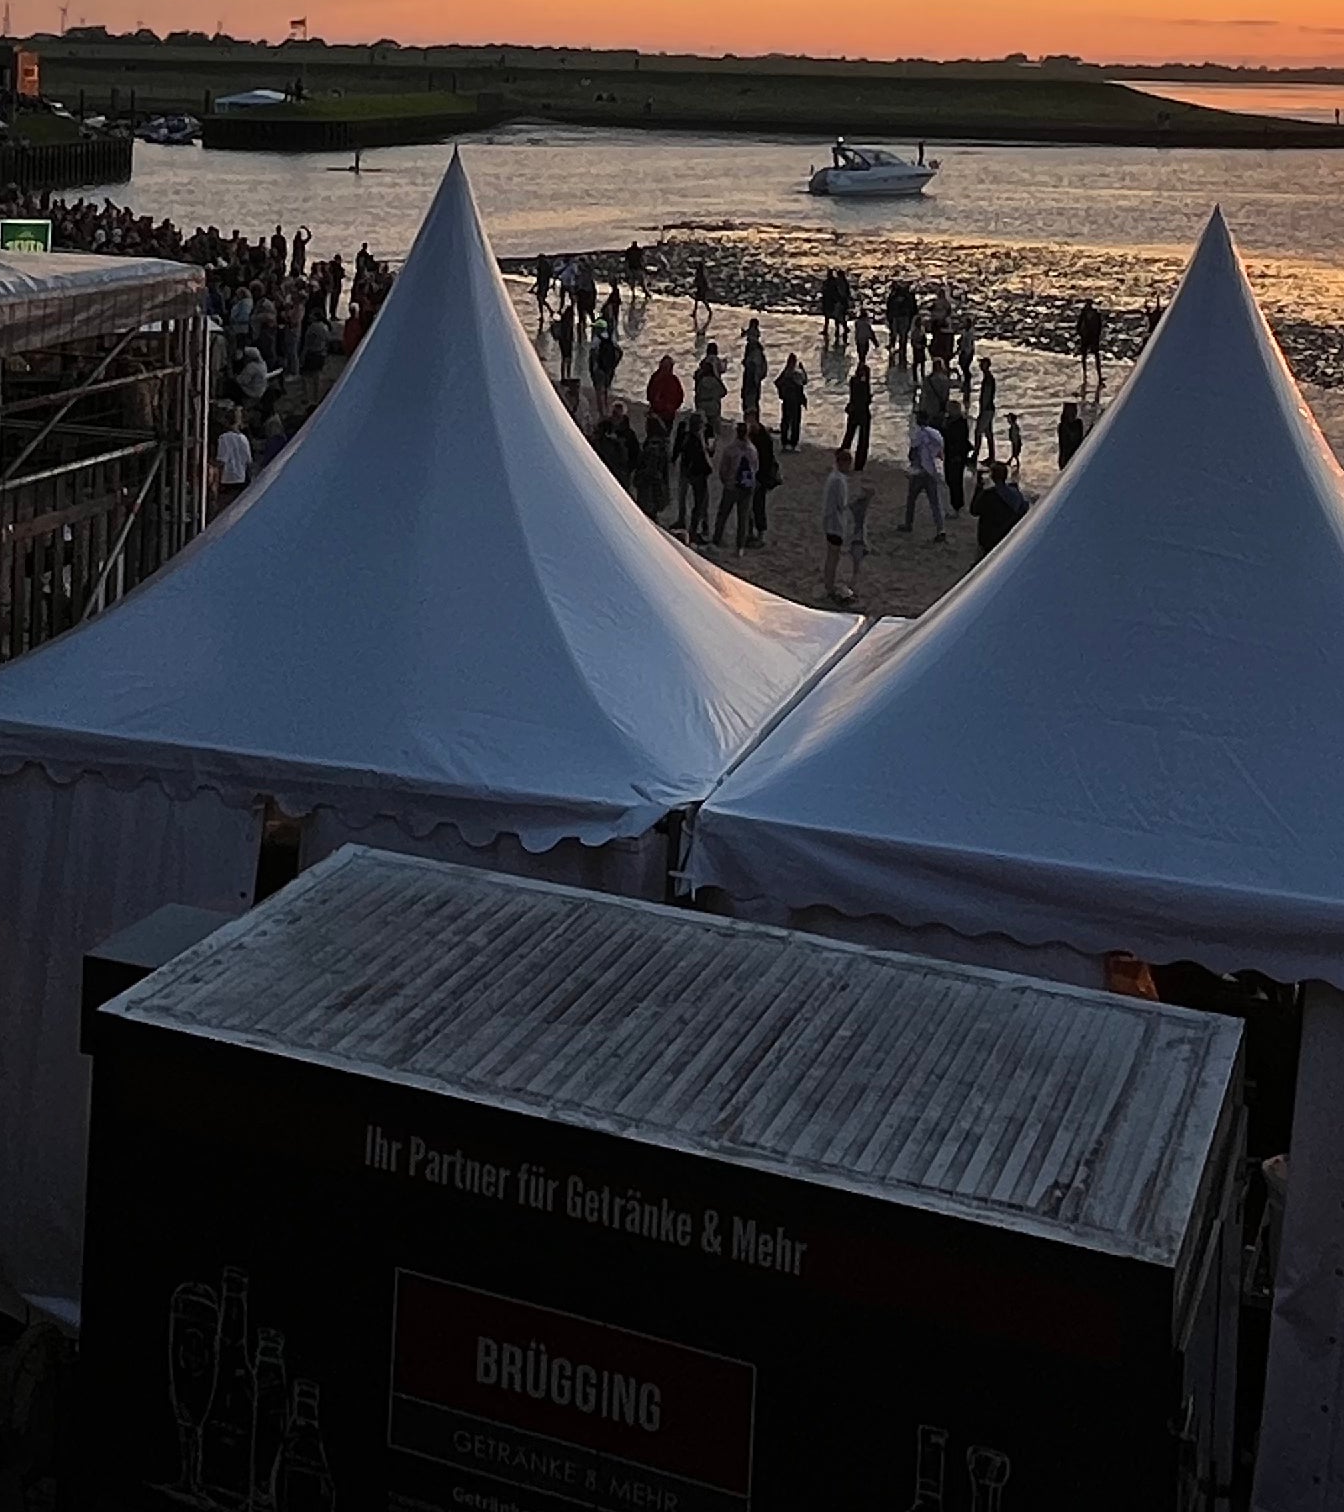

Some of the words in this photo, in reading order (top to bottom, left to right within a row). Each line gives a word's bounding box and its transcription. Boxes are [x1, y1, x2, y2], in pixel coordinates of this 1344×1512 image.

[365, 1123, 402, 1173] Ihr
[409, 1136, 511, 1200] Partner
[517, 1161, 559, 1212] für
[566, 1174, 692, 1247] Getränke
[700, 1207, 722, 1256] &
[730, 1215, 807, 1277] Mehr
[476, 1336, 662, 1433] BRÜGGING
[608, 1475, 679, 1512] MEHR
